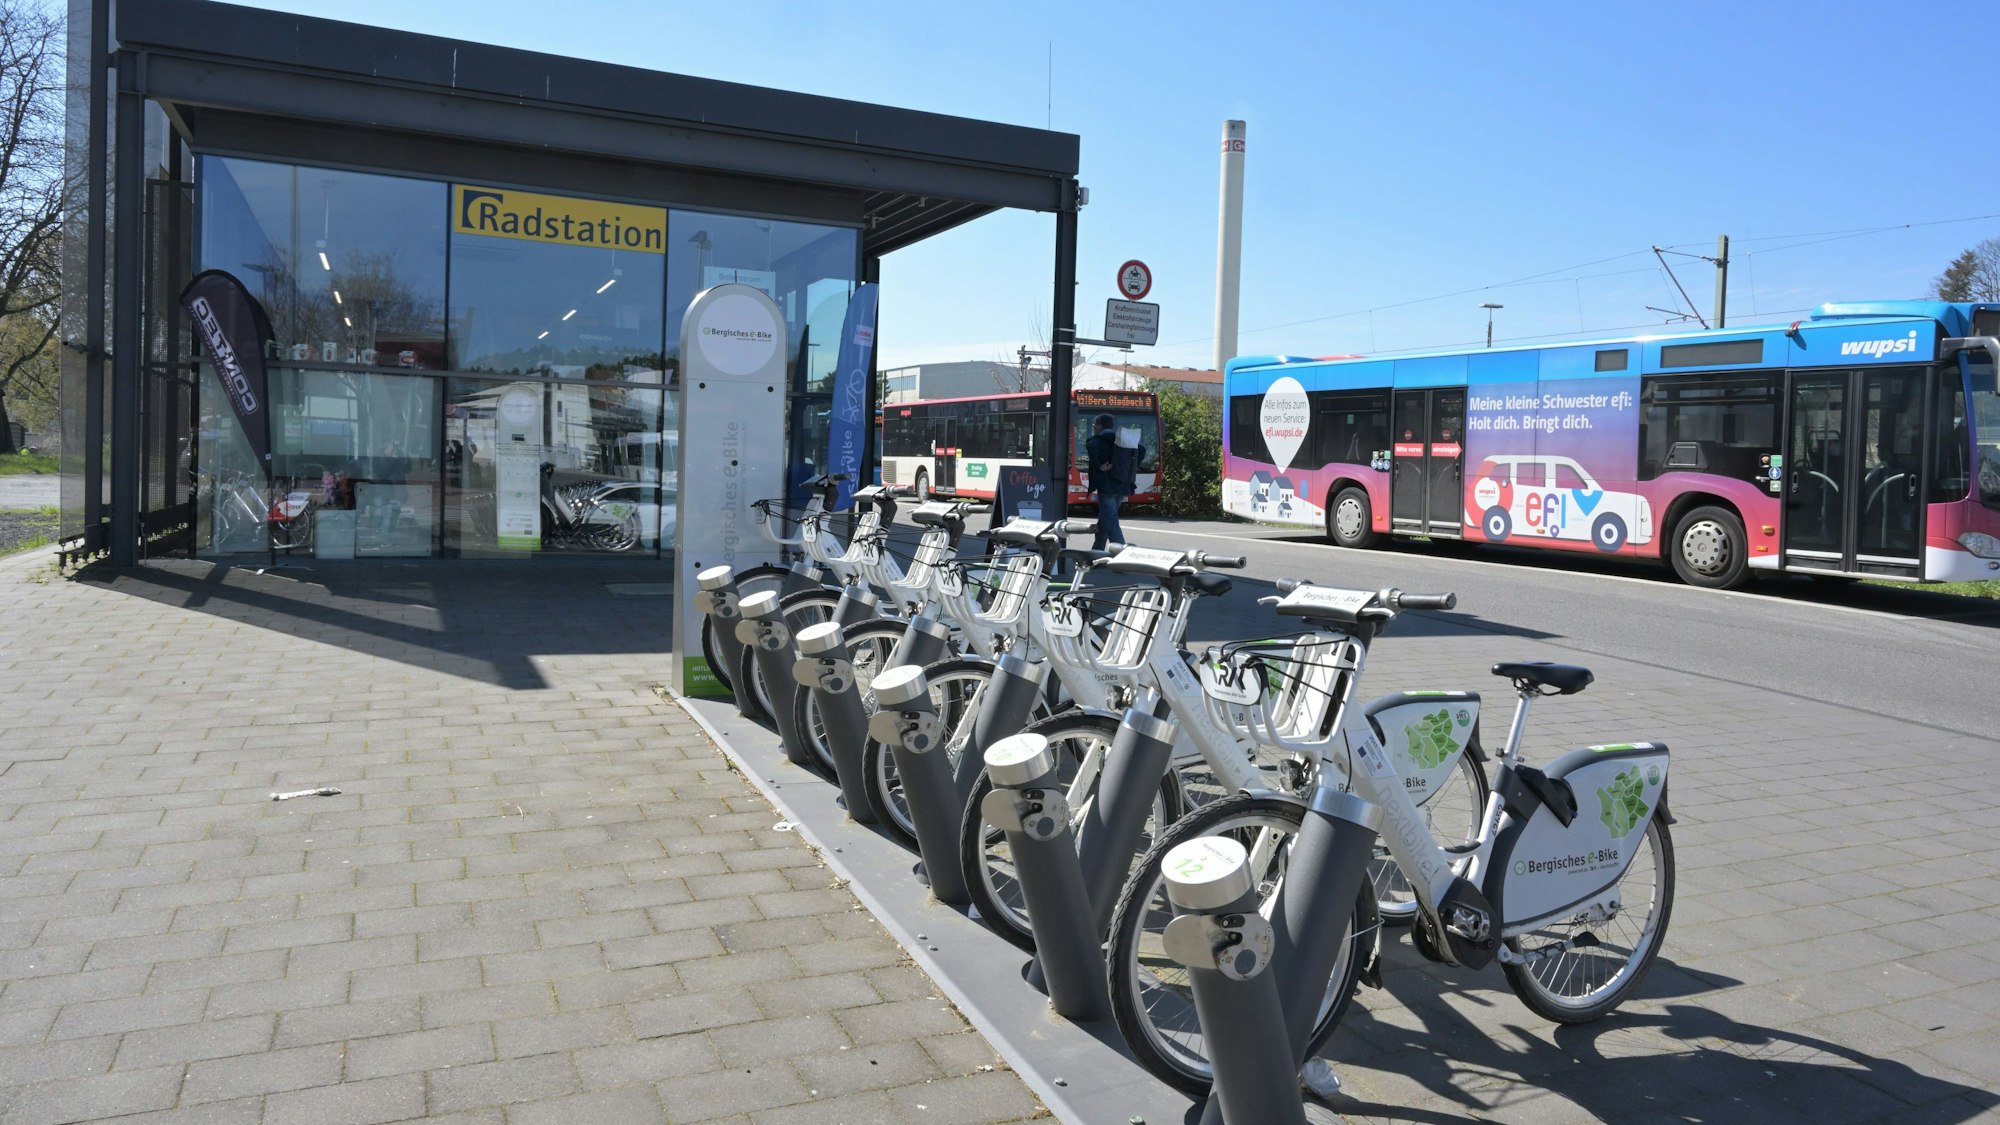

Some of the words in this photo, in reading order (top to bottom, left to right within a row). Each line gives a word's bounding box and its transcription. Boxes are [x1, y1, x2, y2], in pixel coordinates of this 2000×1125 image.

[479, 202, 661, 249] Radstation
[718, 272, 761, 283] Solastrom
[1113, 312, 1152, 324] Elektrofahrzeuge
[711, 328, 749, 337] Bergisches
[749, 330, 772, 339] e-Bike
[1107, 321, 1156, 333] Carsharingfahrzeuge
[1841, 330, 1917, 358] wupsi
[1264, 400, 1276, 409] Alle
[1276, 399, 1292, 411] Infos
[1293, 401, 1307, 409] zum
[1469, 397, 1503, 411] Meine
[1505, 395, 1540, 410] kleine
[1542, 393, 1608, 410] Schwester
[1610, 391, 1632, 411] efi:
[1263, 415, 1282, 423] neuen
[1469, 416, 1492, 430] Holt
[1493, 415, 1520, 430] dich.
[1523, 414, 1560, 433] Bringt
[1562, 415, 1593, 430] dich.
[1265, 427, 1303, 439] efi.wupsi.de
[722, 421, 739, 478] eBike
[1432, 446, 1459, 454] einsteigen
[1010, 470, 1040, 486] Coffee
[1027, 484, 1034, 493] to
[1034, 484, 1046, 499] go
[1479, 487, 1496, 496] wupsi
[1525, 492, 1567, 528] efi
[721, 483, 740, 572] ergisches
[1174, 858, 1204, 878] 12
[1528, 854, 1586, 874] Bergisches
[1587, 849, 1618, 864] e-Bike
